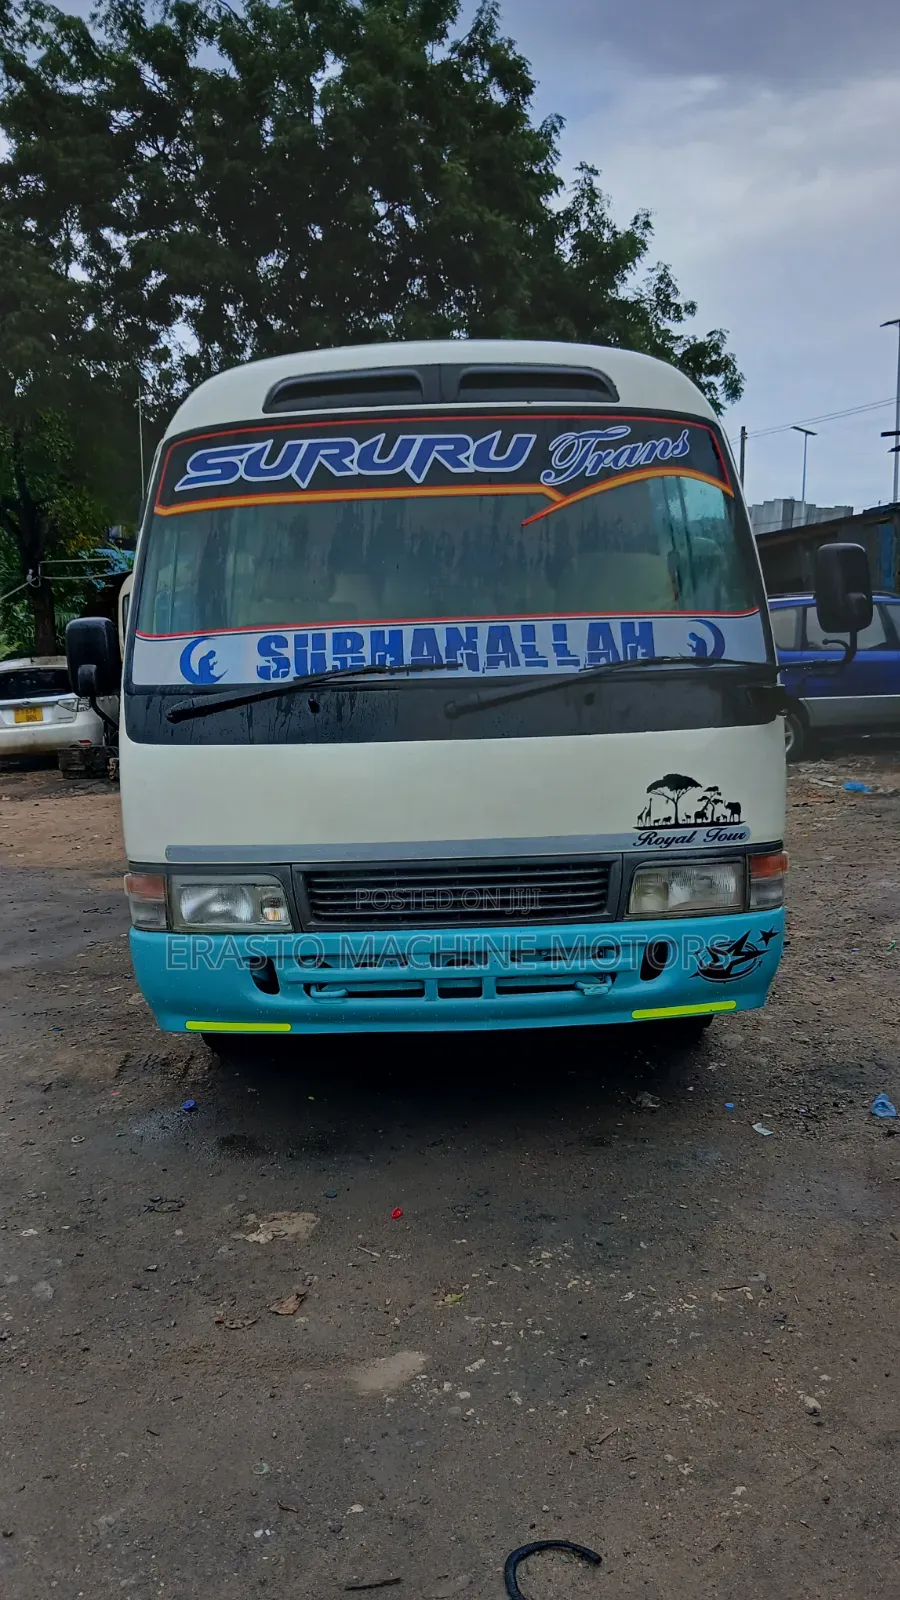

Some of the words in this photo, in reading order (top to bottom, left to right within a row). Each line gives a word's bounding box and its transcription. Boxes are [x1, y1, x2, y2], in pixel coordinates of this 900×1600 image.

[174, 430, 538, 491] SURURU
[540, 425, 690, 486] Trans
[256, 621, 656, 681] SUBHANALLAH
[633, 830, 697, 848] Royal
[703, 827, 747, 842] Tour
